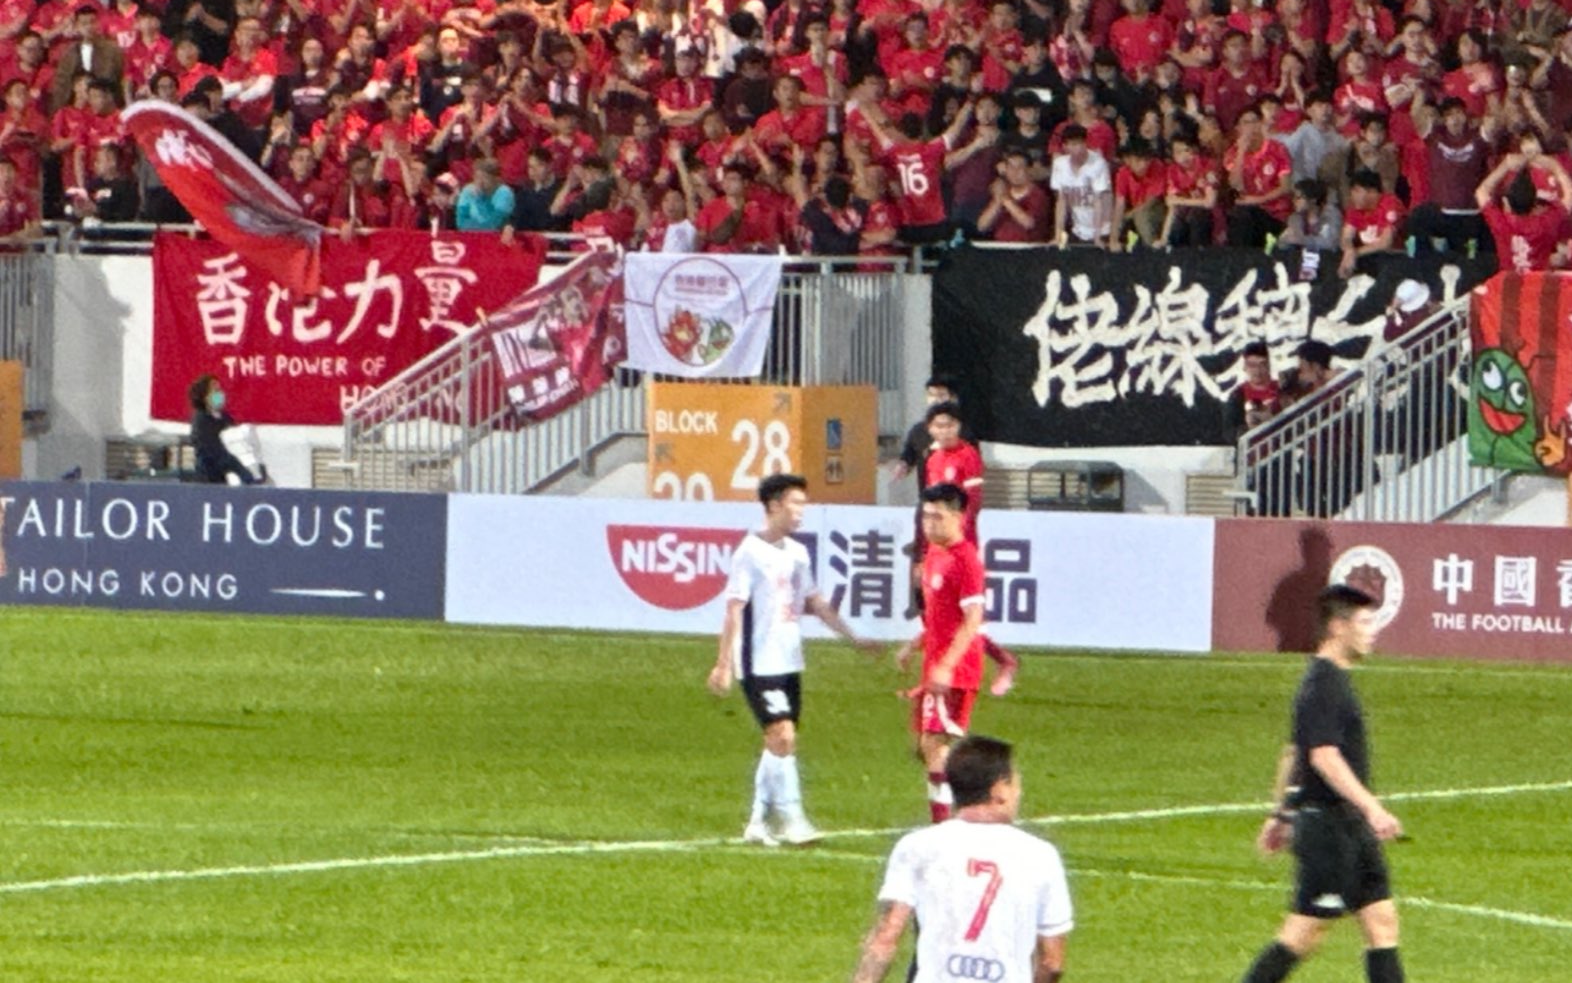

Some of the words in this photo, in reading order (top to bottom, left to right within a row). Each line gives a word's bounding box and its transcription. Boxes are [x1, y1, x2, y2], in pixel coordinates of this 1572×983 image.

[897, 161, 930, 196] 16
[223, 355, 267, 378] THE
[275, 355, 349, 377] POWER
[361, 356, 388, 376] OF
[654, 409, 719, 434] BLOCK
[730, 419, 791, 490] 28
[202, 502, 386, 550] HOUSE
[621, 532, 733, 584] NISSIN
[791, 529, 1037, 624] 清品
[17, 567, 120, 596] HONG
[140, 571, 239, 601] KONG
[1432, 612, 1466, 631] THE
[1471, 613, 1565, 634] FOOTBALL
[966, 858, 1003, 943] 7
